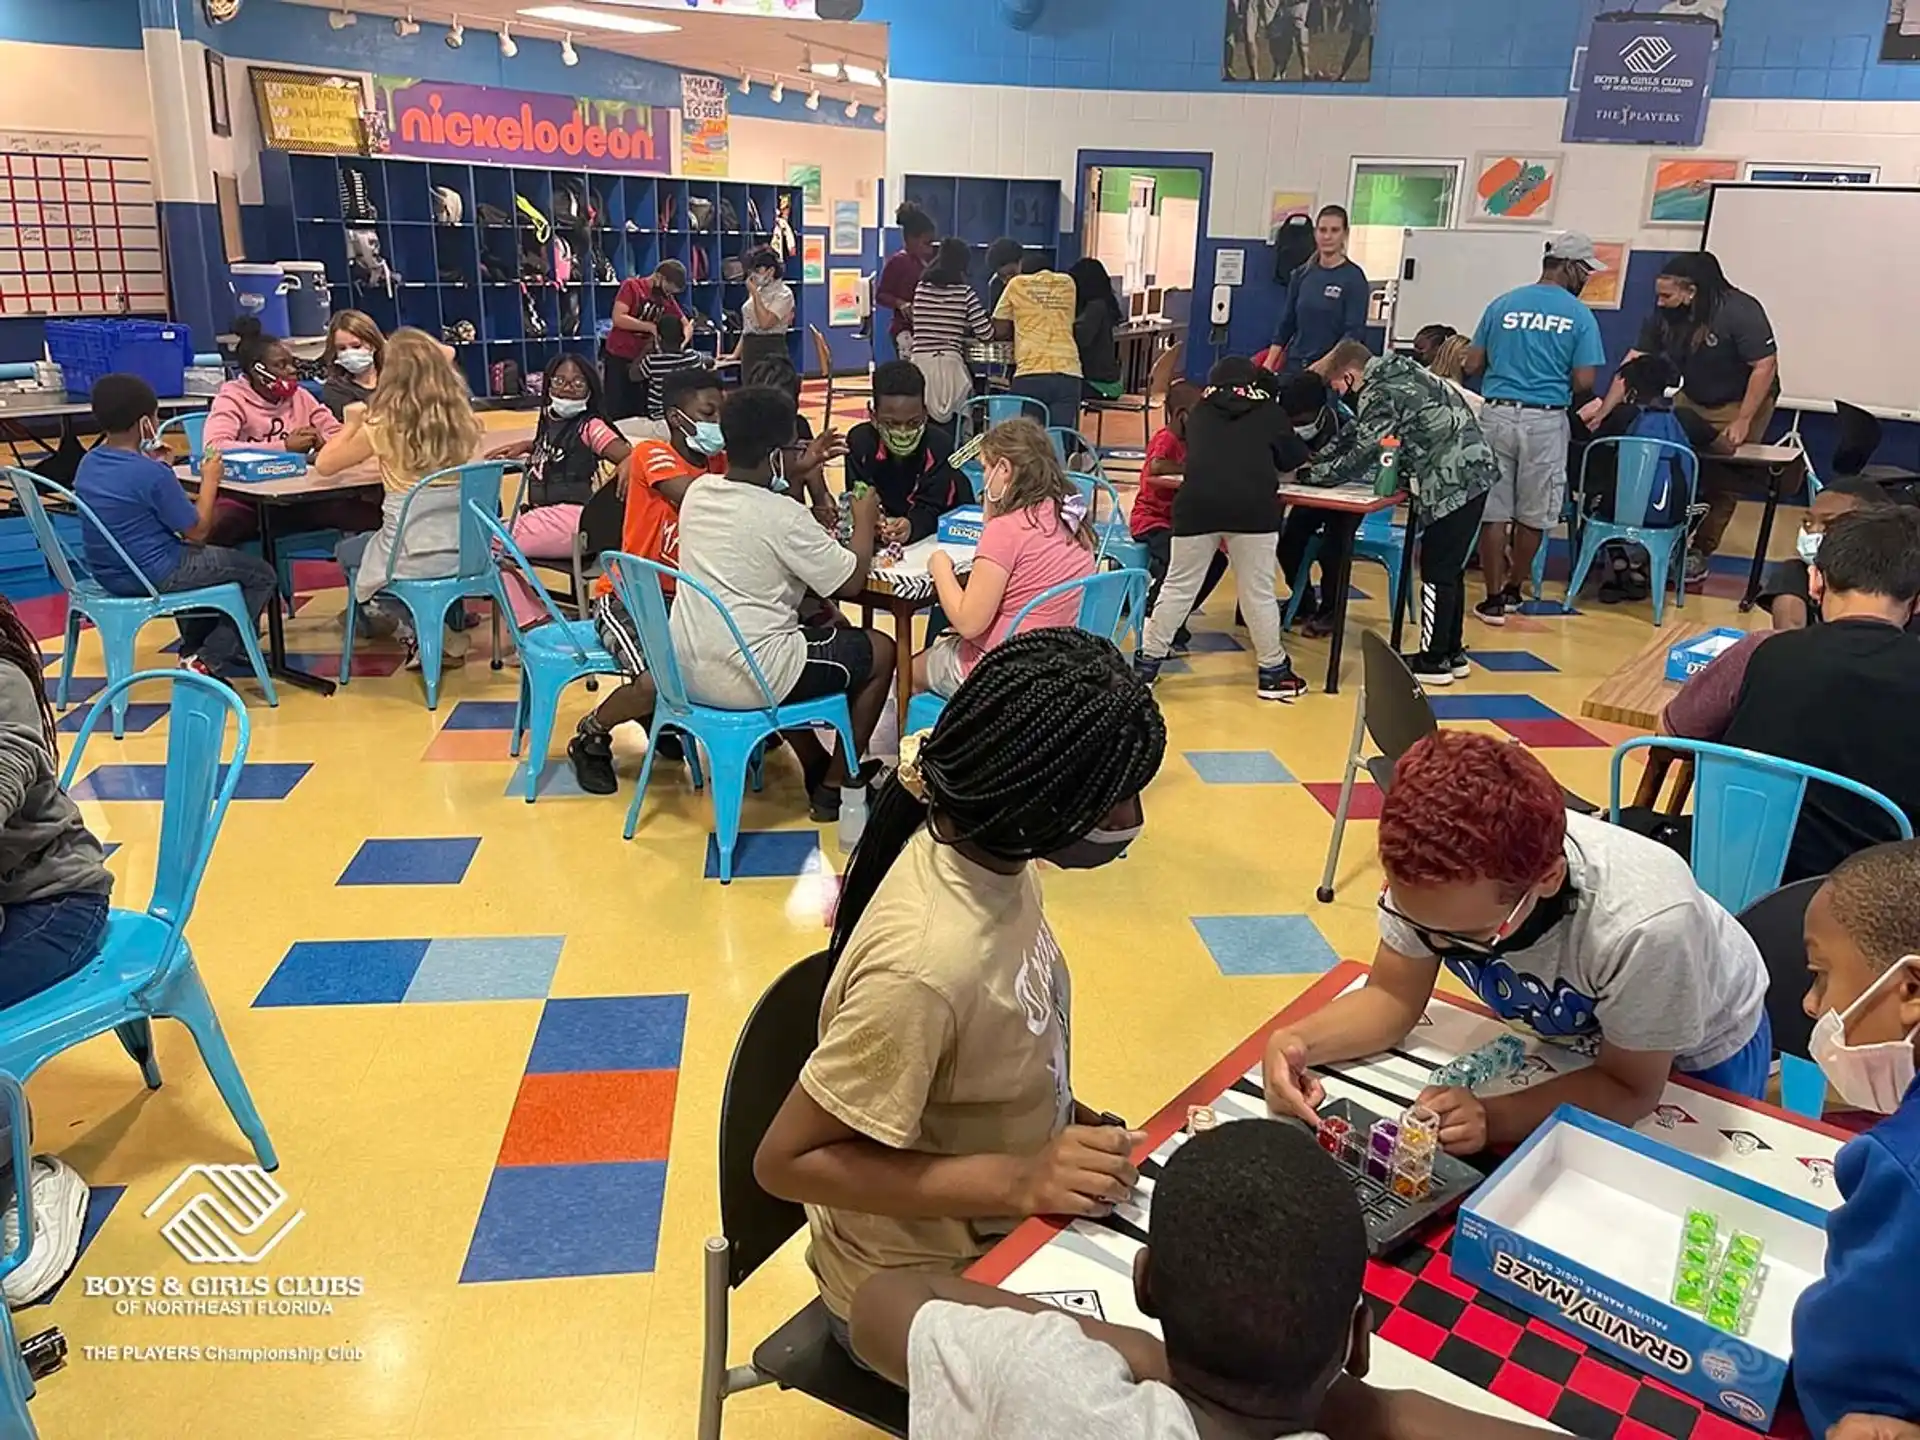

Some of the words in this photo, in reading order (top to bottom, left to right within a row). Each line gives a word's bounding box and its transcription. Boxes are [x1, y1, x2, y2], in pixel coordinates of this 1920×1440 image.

[685, 77, 714, 89] WHAT
[1594, 75, 1619, 84] BOYS
[1621, 76, 1629, 85] &
[1630, 76, 1660, 86] GIRLS
[1661, 78, 1694, 88] CLUBS
[687, 106, 701, 118] TO
[702, 107, 723, 118] SEE?
[1596, 109, 1621, 120] THE
[1629, 111, 1681, 123] PLAYERS
[401, 93, 655, 161] nickelodeon
[1502, 311, 1574, 334] STAFF
[1380, 452, 1394, 467] G
[1527, 1253, 1554, 1271] GAME
[1495, 1252, 1576, 1307] MAZE
[1556, 1267, 1585, 1285] LOGIC
[1586, 1287, 1625, 1310] MARBLE
[1627, 1306, 1669, 1331] FALLING
[1565, 1297, 1691, 1373] GRAVITY
